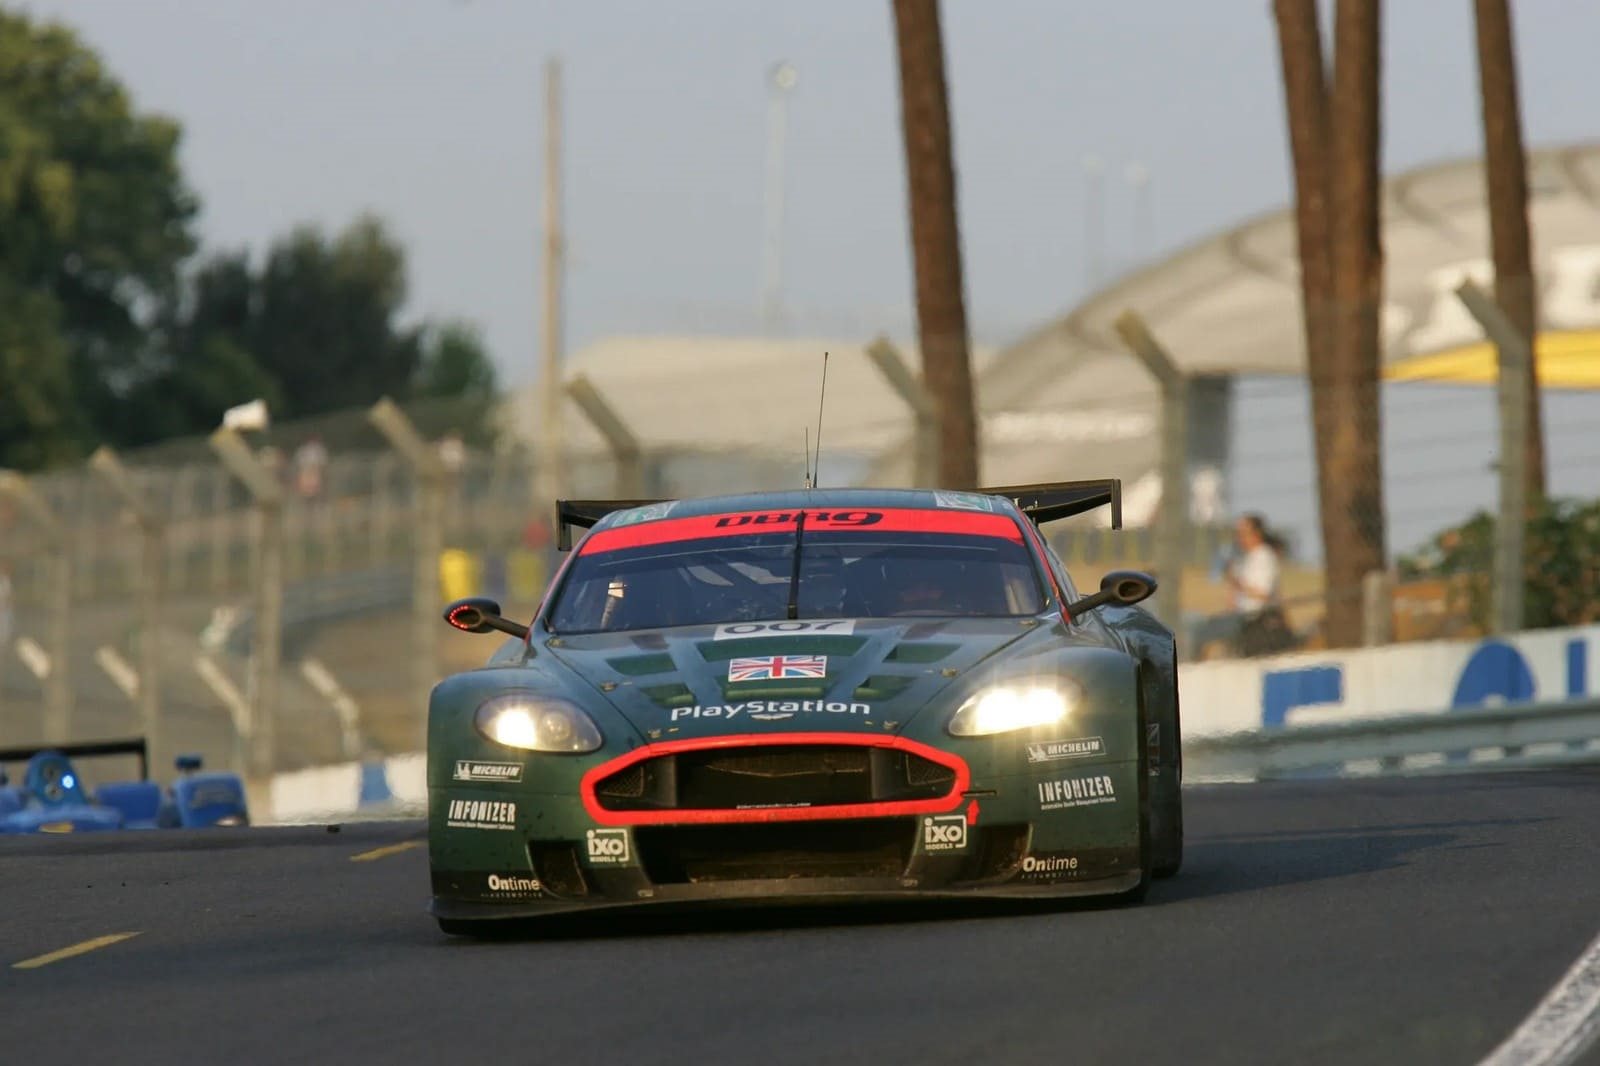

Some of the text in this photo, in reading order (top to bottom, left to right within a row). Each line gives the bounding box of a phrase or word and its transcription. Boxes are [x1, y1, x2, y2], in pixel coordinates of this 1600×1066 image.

[715, 511, 884, 528] DBR9
[724, 620, 847, 635] 007
[670, 700, 871, 721] PlayStation
[1047, 741, 1100, 755] MICHELIN
[471, 765, 520, 777] MICHELIN
[1038, 775, 1114, 803] INFONIZER
[448, 799, 516, 823] INFONIZER
[1023, 856, 1078, 872] Ontime
[488, 874, 541, 891] Ontime
